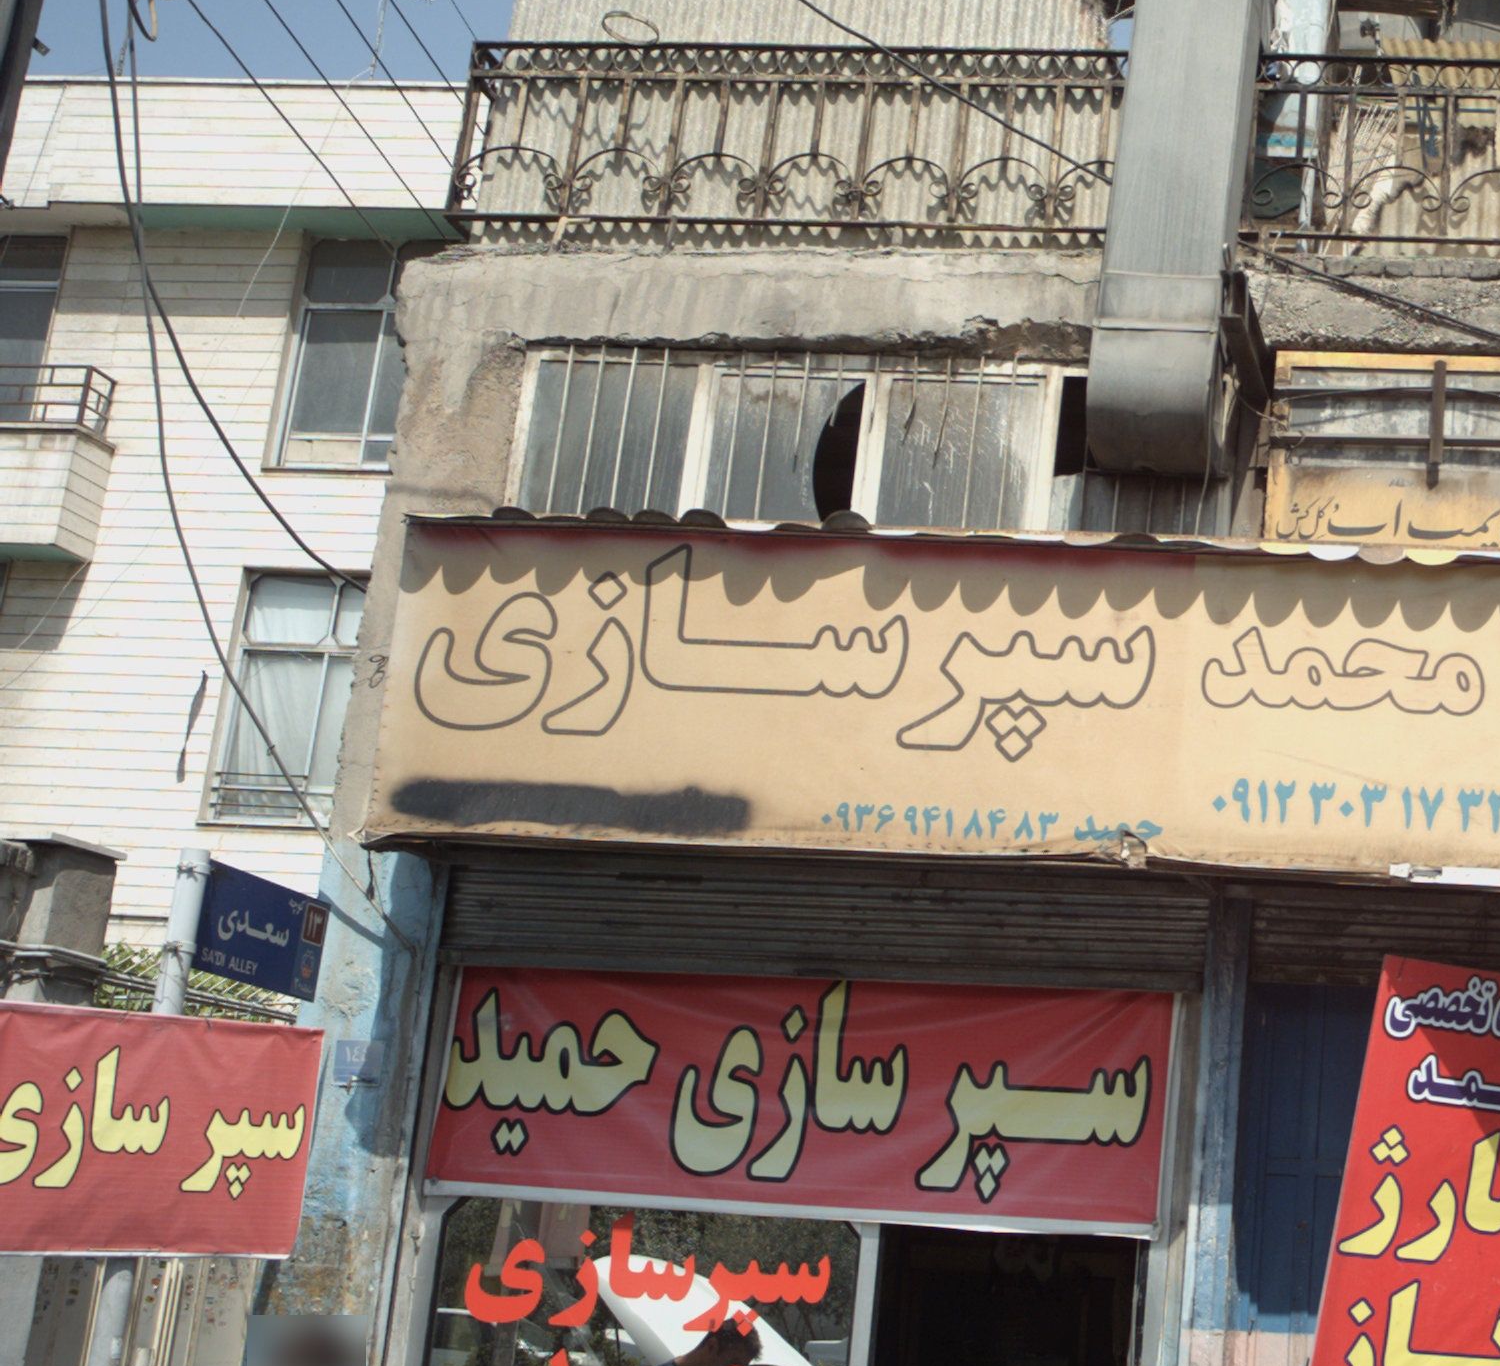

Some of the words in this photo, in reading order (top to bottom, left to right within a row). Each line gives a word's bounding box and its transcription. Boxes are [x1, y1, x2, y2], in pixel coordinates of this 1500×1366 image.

[1201, 625, 1485, 716] محمد
[217, 909, 290, 948] سعدی
[228, 955, 259, 977] ALLEY
[443, 987, 660, 1155] حمید
